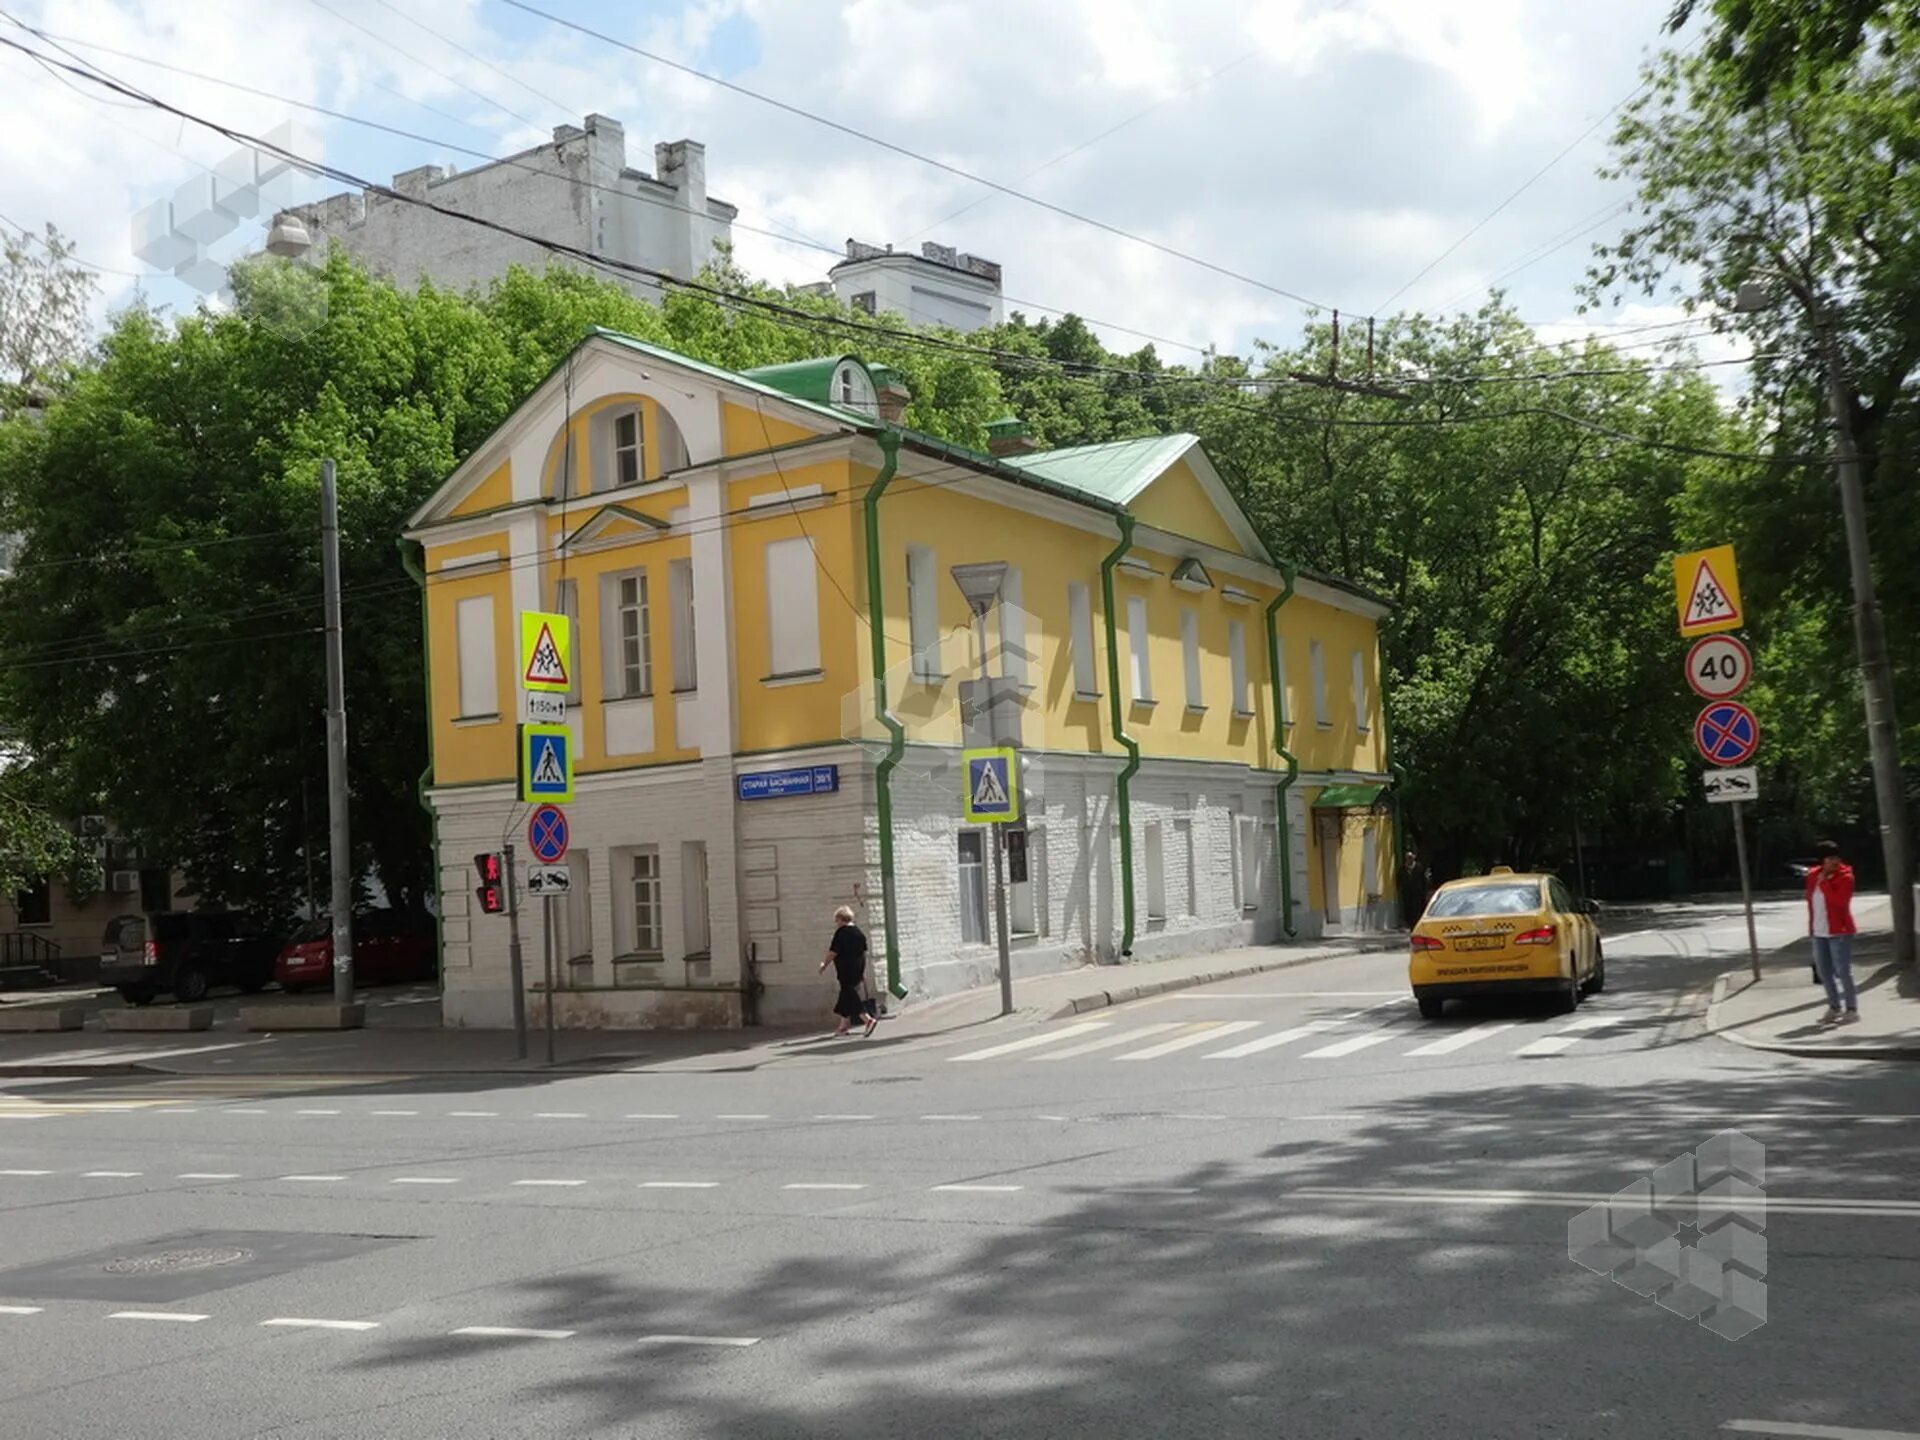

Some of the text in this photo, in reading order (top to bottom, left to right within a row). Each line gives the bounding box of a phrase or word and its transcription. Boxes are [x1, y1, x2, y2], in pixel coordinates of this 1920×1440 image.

[1700, 654, 1737, 680] 40
[743, 775, 809, 790] СТАРАЯ БАСМАННАЯ
[487, 890, 497, 909] 5
